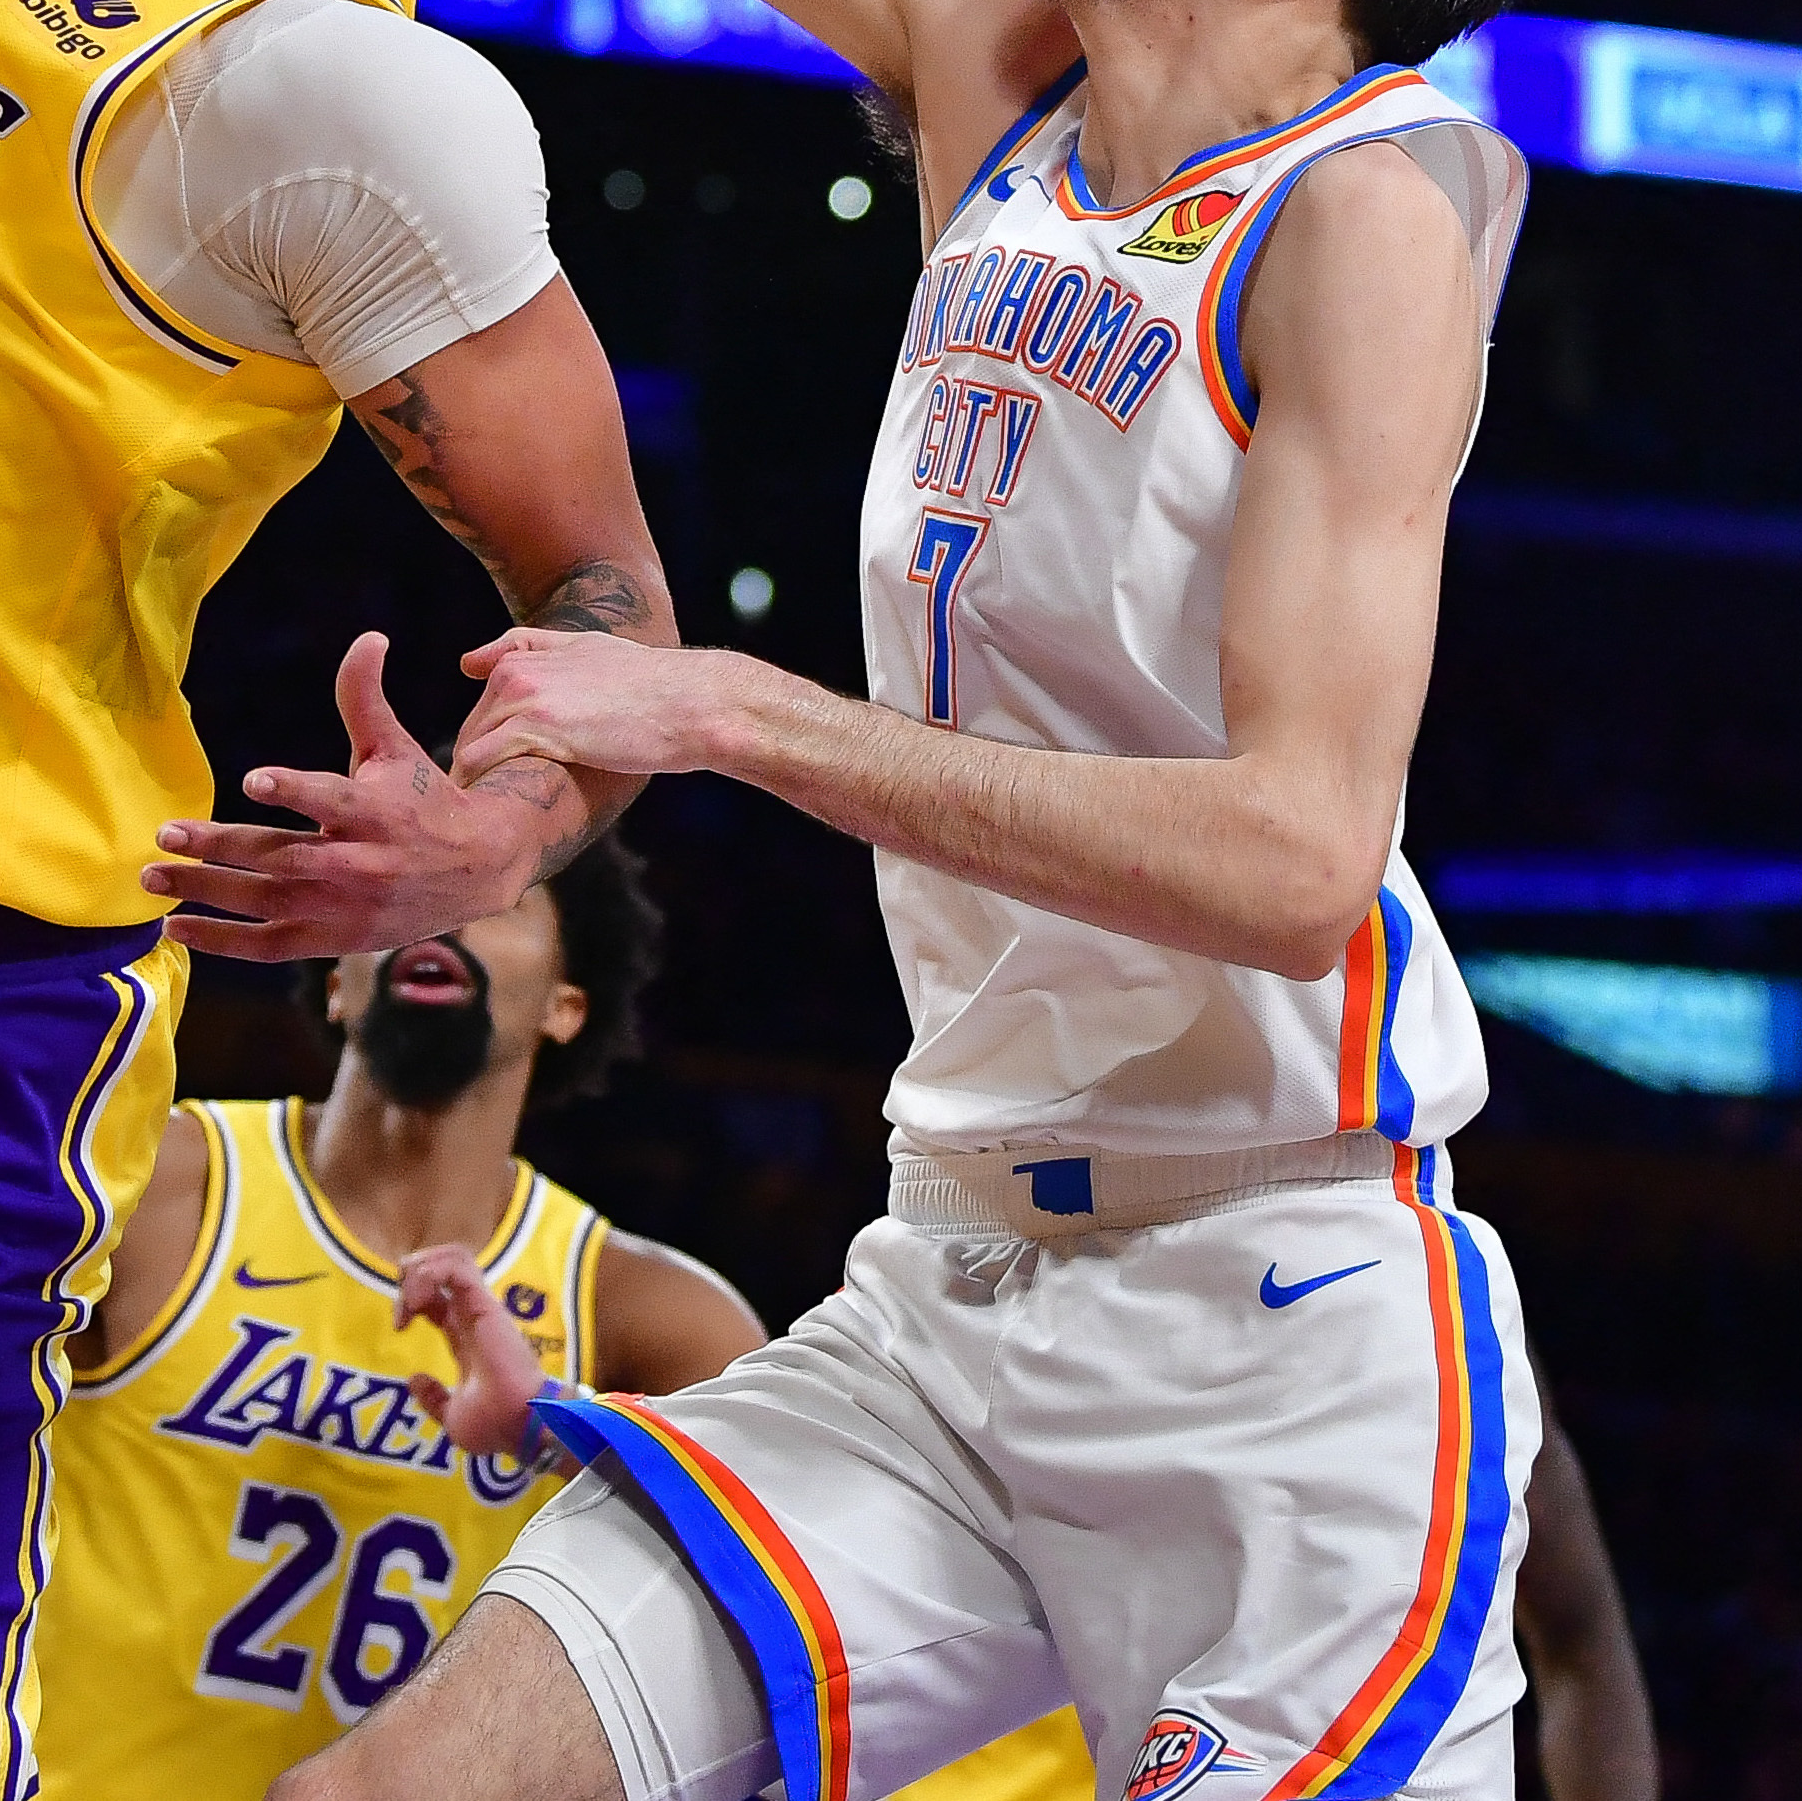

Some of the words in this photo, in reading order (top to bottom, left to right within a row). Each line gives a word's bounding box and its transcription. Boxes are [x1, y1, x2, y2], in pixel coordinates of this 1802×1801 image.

[902, 245, 1182, 433] OKAHOMA
[912, 375, 1042, 506] CITY
[907, 506, 990, 730] 7
[193, 1480, 458, 1723] 26
